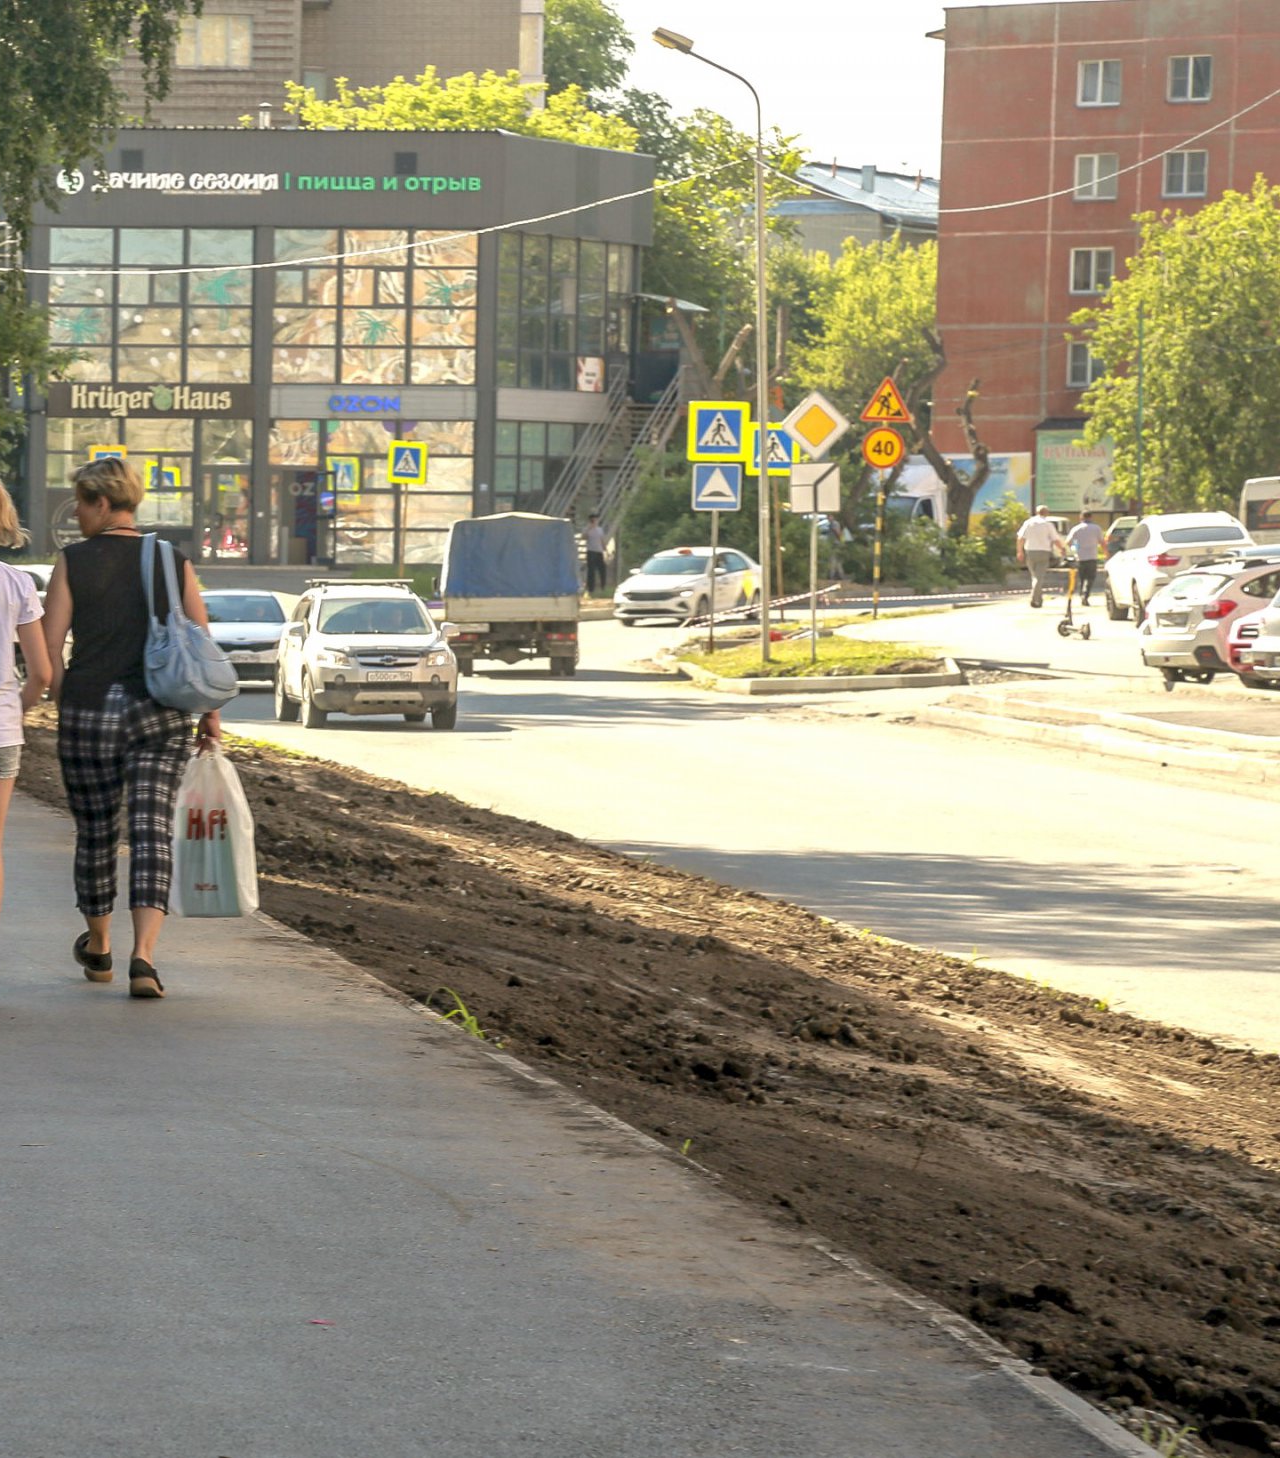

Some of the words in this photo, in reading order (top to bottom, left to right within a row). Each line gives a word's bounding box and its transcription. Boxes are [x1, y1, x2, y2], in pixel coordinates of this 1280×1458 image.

[188, 171, 279, 190] сезоны
[297, 176, 376, 191] пицца
[382, 177, 398, 191] и
[404, 176, 482, 195] отрыв
[71, 384, 154, 417] Krüger
[173, 385, 232, 410] Haus
[328, 395, 401, 412] OZON
[872, 440, 895, 456] 40
